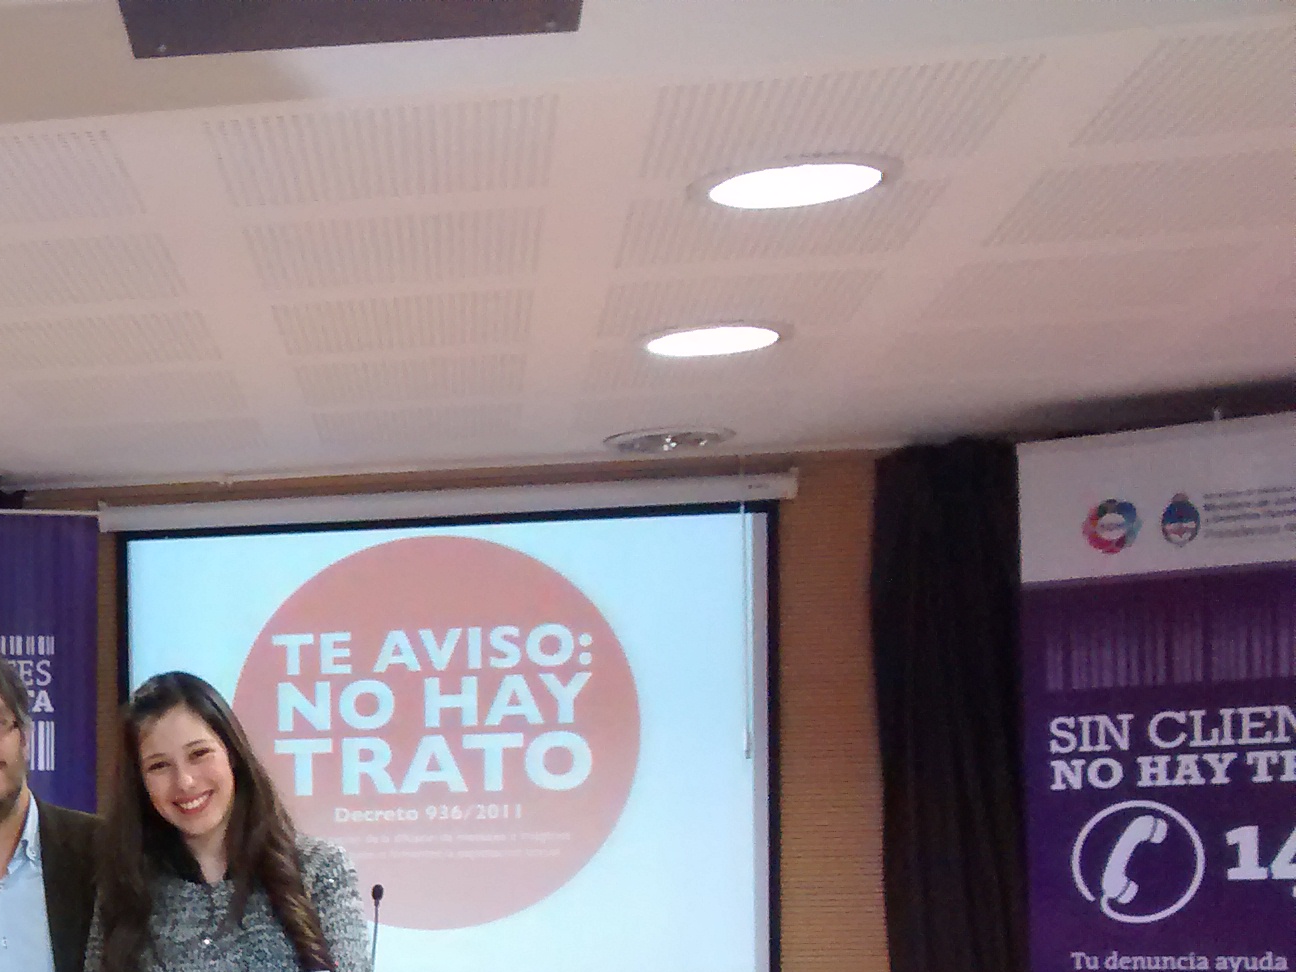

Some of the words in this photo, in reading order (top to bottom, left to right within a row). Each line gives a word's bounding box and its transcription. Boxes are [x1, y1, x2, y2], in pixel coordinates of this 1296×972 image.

[271, 632, 352, 675] TE
[373, 622, 593, 673] AVISO:
[277, 679, 395, 731] NO
[424, 671, 592, 727] HAY
[1049, 713, 1135, 754] SIN
[274, 730, 593, 797] TRATO
[1050, 757, 1125, 791] NO
[1136, 752, 1239, 788] HAY
[334, 806, 418, 823] Decreto
[1070, 951, 1100, 970] Tu
[1104, 950, 1209, 971] denuncia
